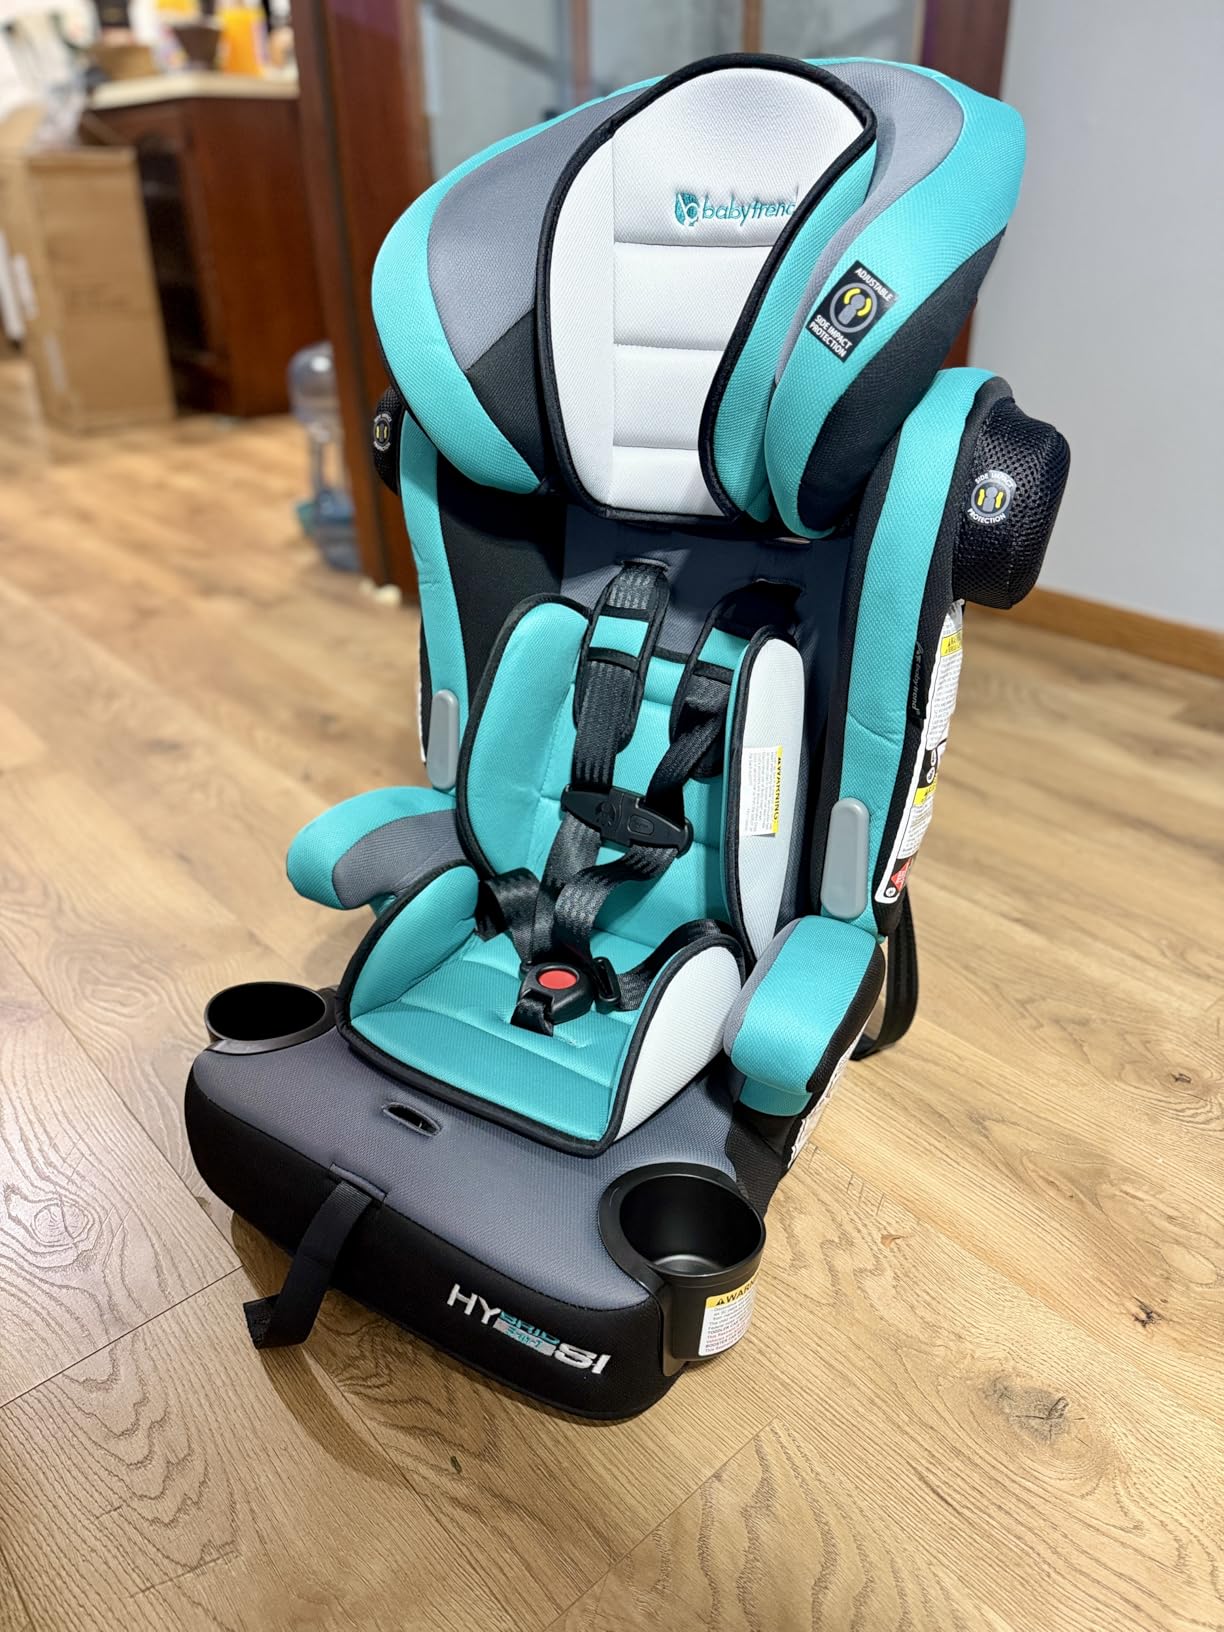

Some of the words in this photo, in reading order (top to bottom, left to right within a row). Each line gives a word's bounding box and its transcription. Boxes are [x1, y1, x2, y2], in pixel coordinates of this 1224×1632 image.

[854, 267, 894, 301] ADJUSTABLE
[808, 321, 848, 358] PROTECTION
[813, 314, 831, 332] SIDE
[827, 326, 853, 349] IMPACT
[967, 508, 1006, 524] PROTECTION
